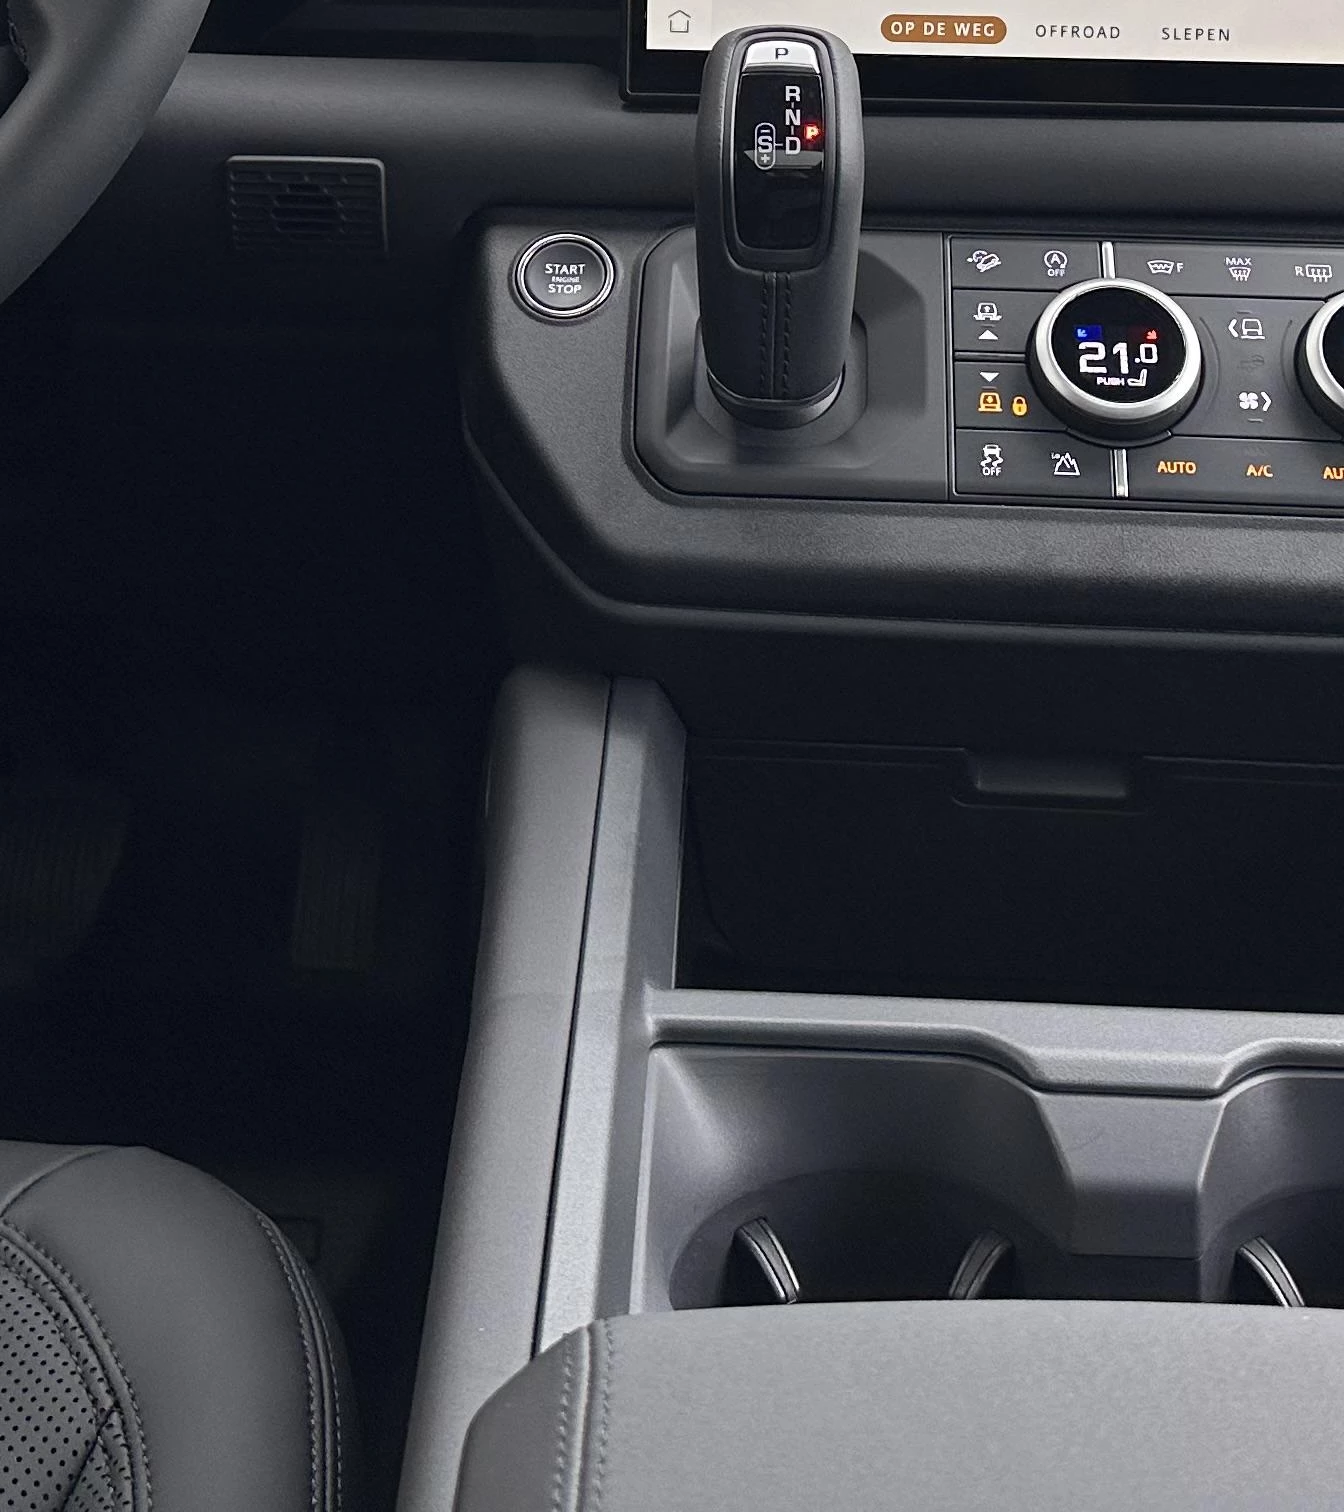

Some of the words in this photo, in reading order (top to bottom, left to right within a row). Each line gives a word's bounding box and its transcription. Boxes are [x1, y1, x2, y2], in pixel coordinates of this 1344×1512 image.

[890, 20, 916, 36] OP
[922, 21, 946, 36] DE
[953, 22, 996, 37] WEG
[1035, 24, 1122, 40] OFFROAD
[1160, 26, 1231, 42] SLEPEN
[775, 47, 789, 60] P
[785, 85, 801, 102] R
[785, 109, 801, 126] N
[785, 136, 801, 155] D
[1176, 263, 1184, 273] F
[1225, 257, 1252, 266] MAX
[544, 263, 586, 275] START
[1047, 269, 1066, 277] OFF
[1294, 265, 1304, 277] R
[548, 283, 582, 294] STOP
[1078, 341, 1159, 374] 21.0
[1096, 377, 1125, 386] PUSH
[982, 466, 1002, 476] OFF
[1157, 461, 1197, 474] AUTO
[1246, 464, 1274, 478] A/C
